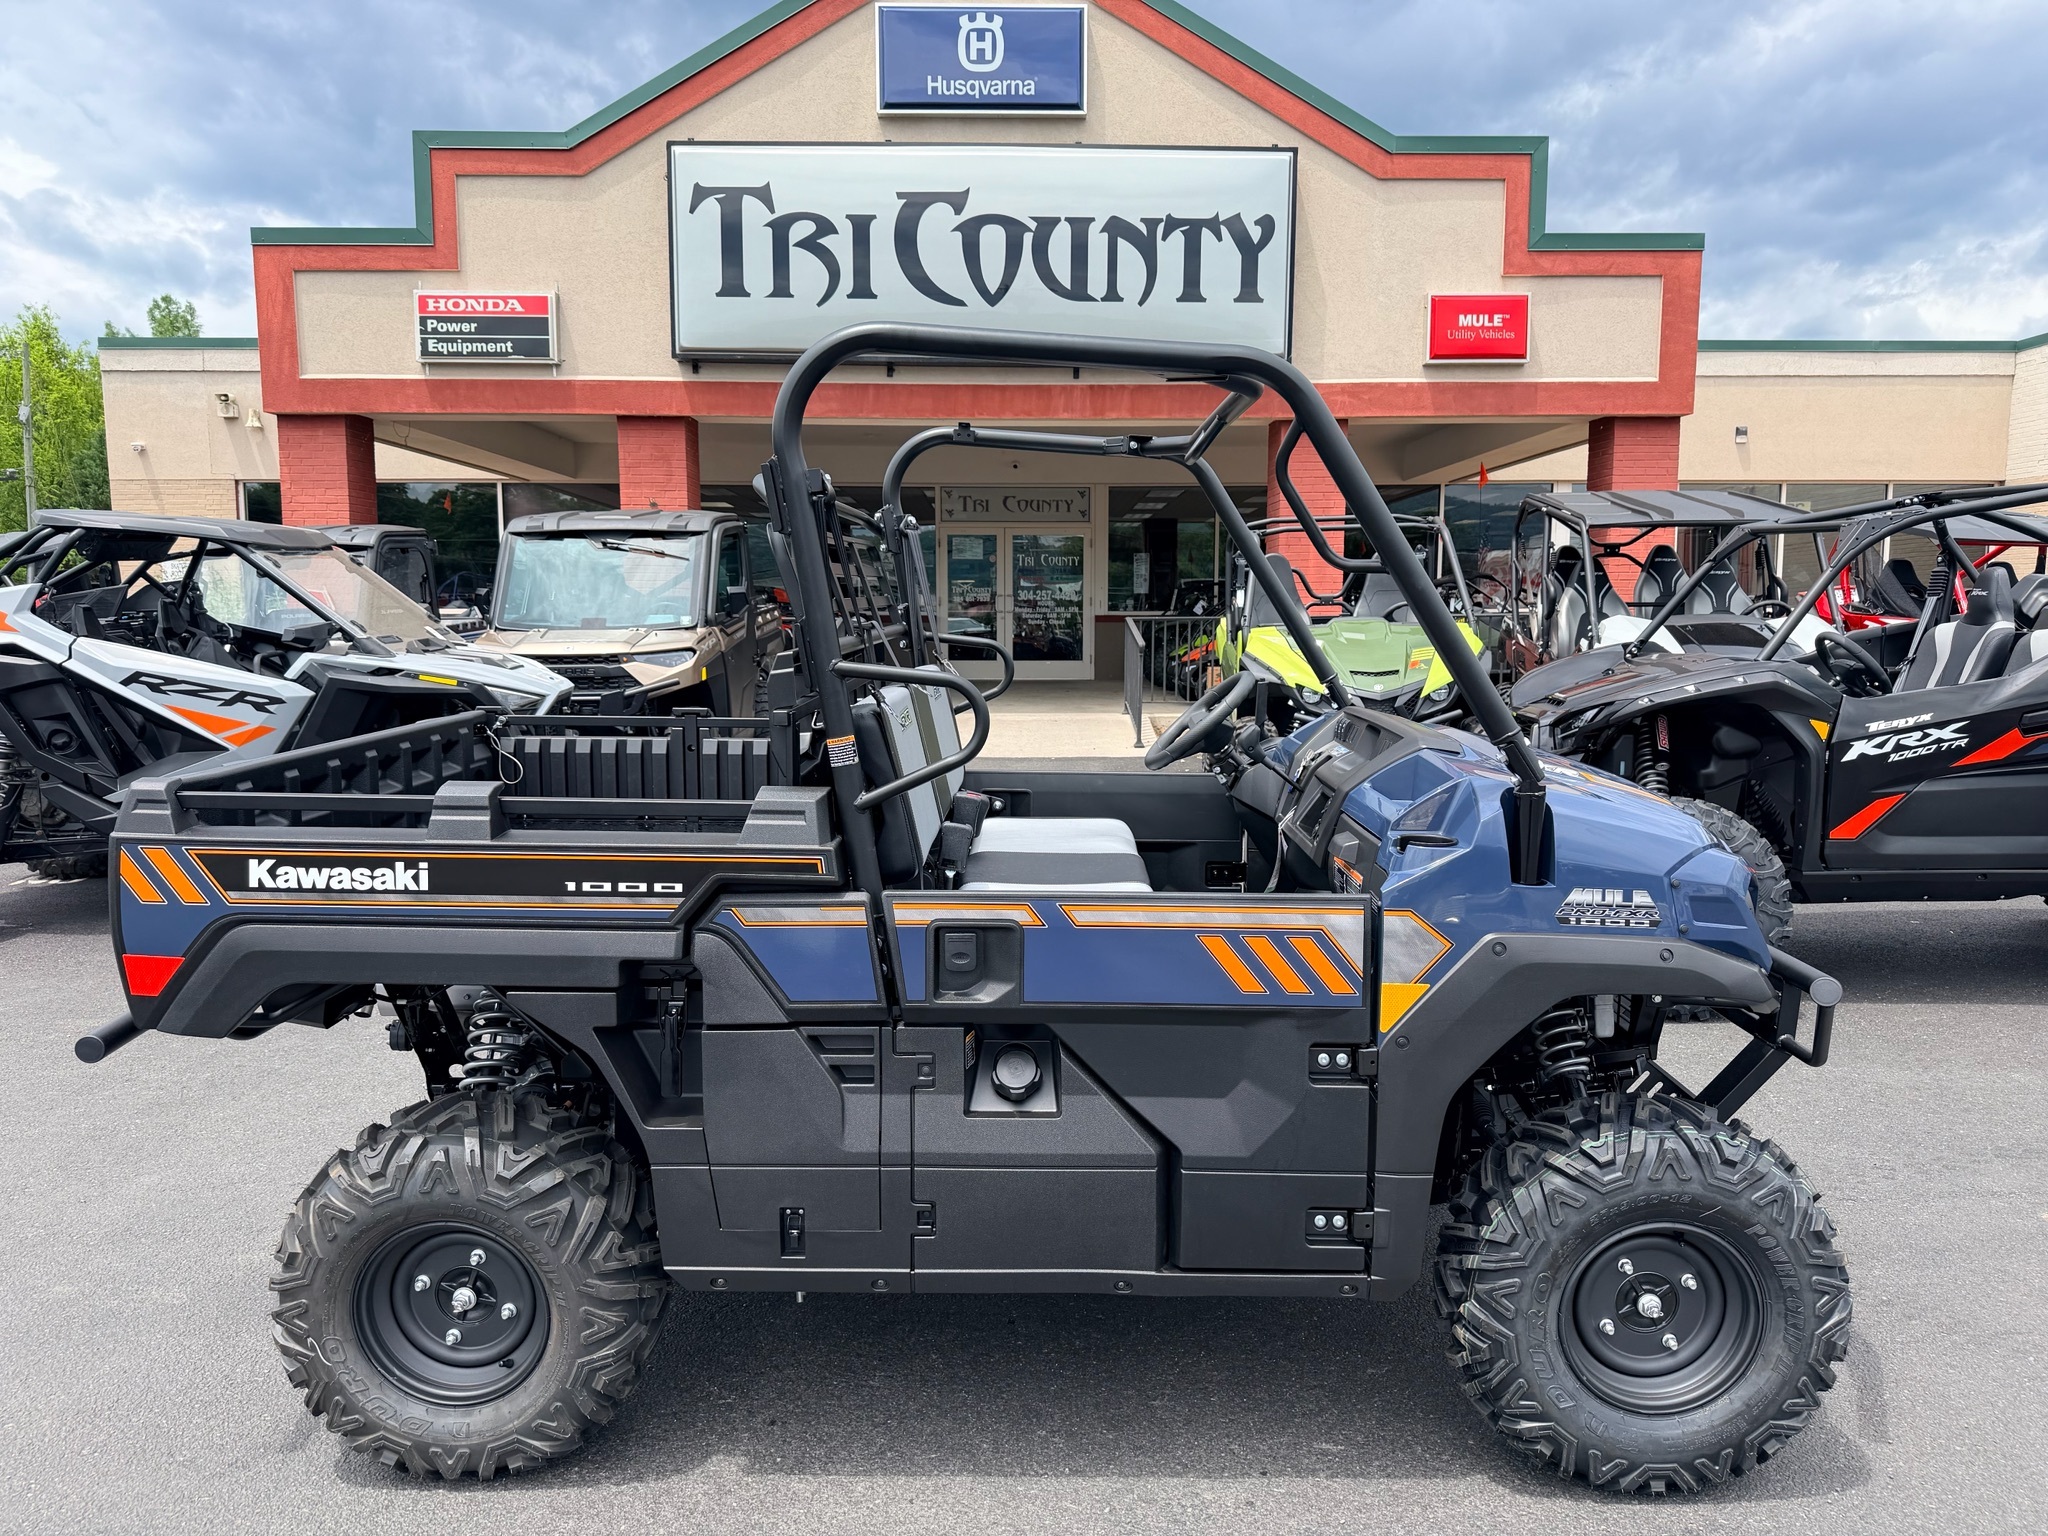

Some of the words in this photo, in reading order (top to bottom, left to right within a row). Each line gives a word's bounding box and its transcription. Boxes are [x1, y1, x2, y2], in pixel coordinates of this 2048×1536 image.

[927, 75, 1036, 99] Husqvarna
[426, 298, 525, 312] HONDA
[426, 319, 477, 332] Power
[1447, 330, 1476, 341] Utility
[1479, 330, 1516, 339] Vehicles
[427, 339, 514, 354] Equipment
[700, 637, 716, 654] XP
[119, 670, 287, 715] RZR
[1840, 720, 1971, 762] KRX
[248, 858, 429, 892] Kawasaki
[565, 881, 684, 893] 1000
[1561, 888, 1657, 908] MULE
[1569, 917, 1650, 928] 1000
[1743, 1223, 1801, 1293] POWER
[1783, 1295, 1806, 1354] GRIP
[1527, 1272, 1577, 1410] DURO
[321, 1336, 434, 1437] DURO
